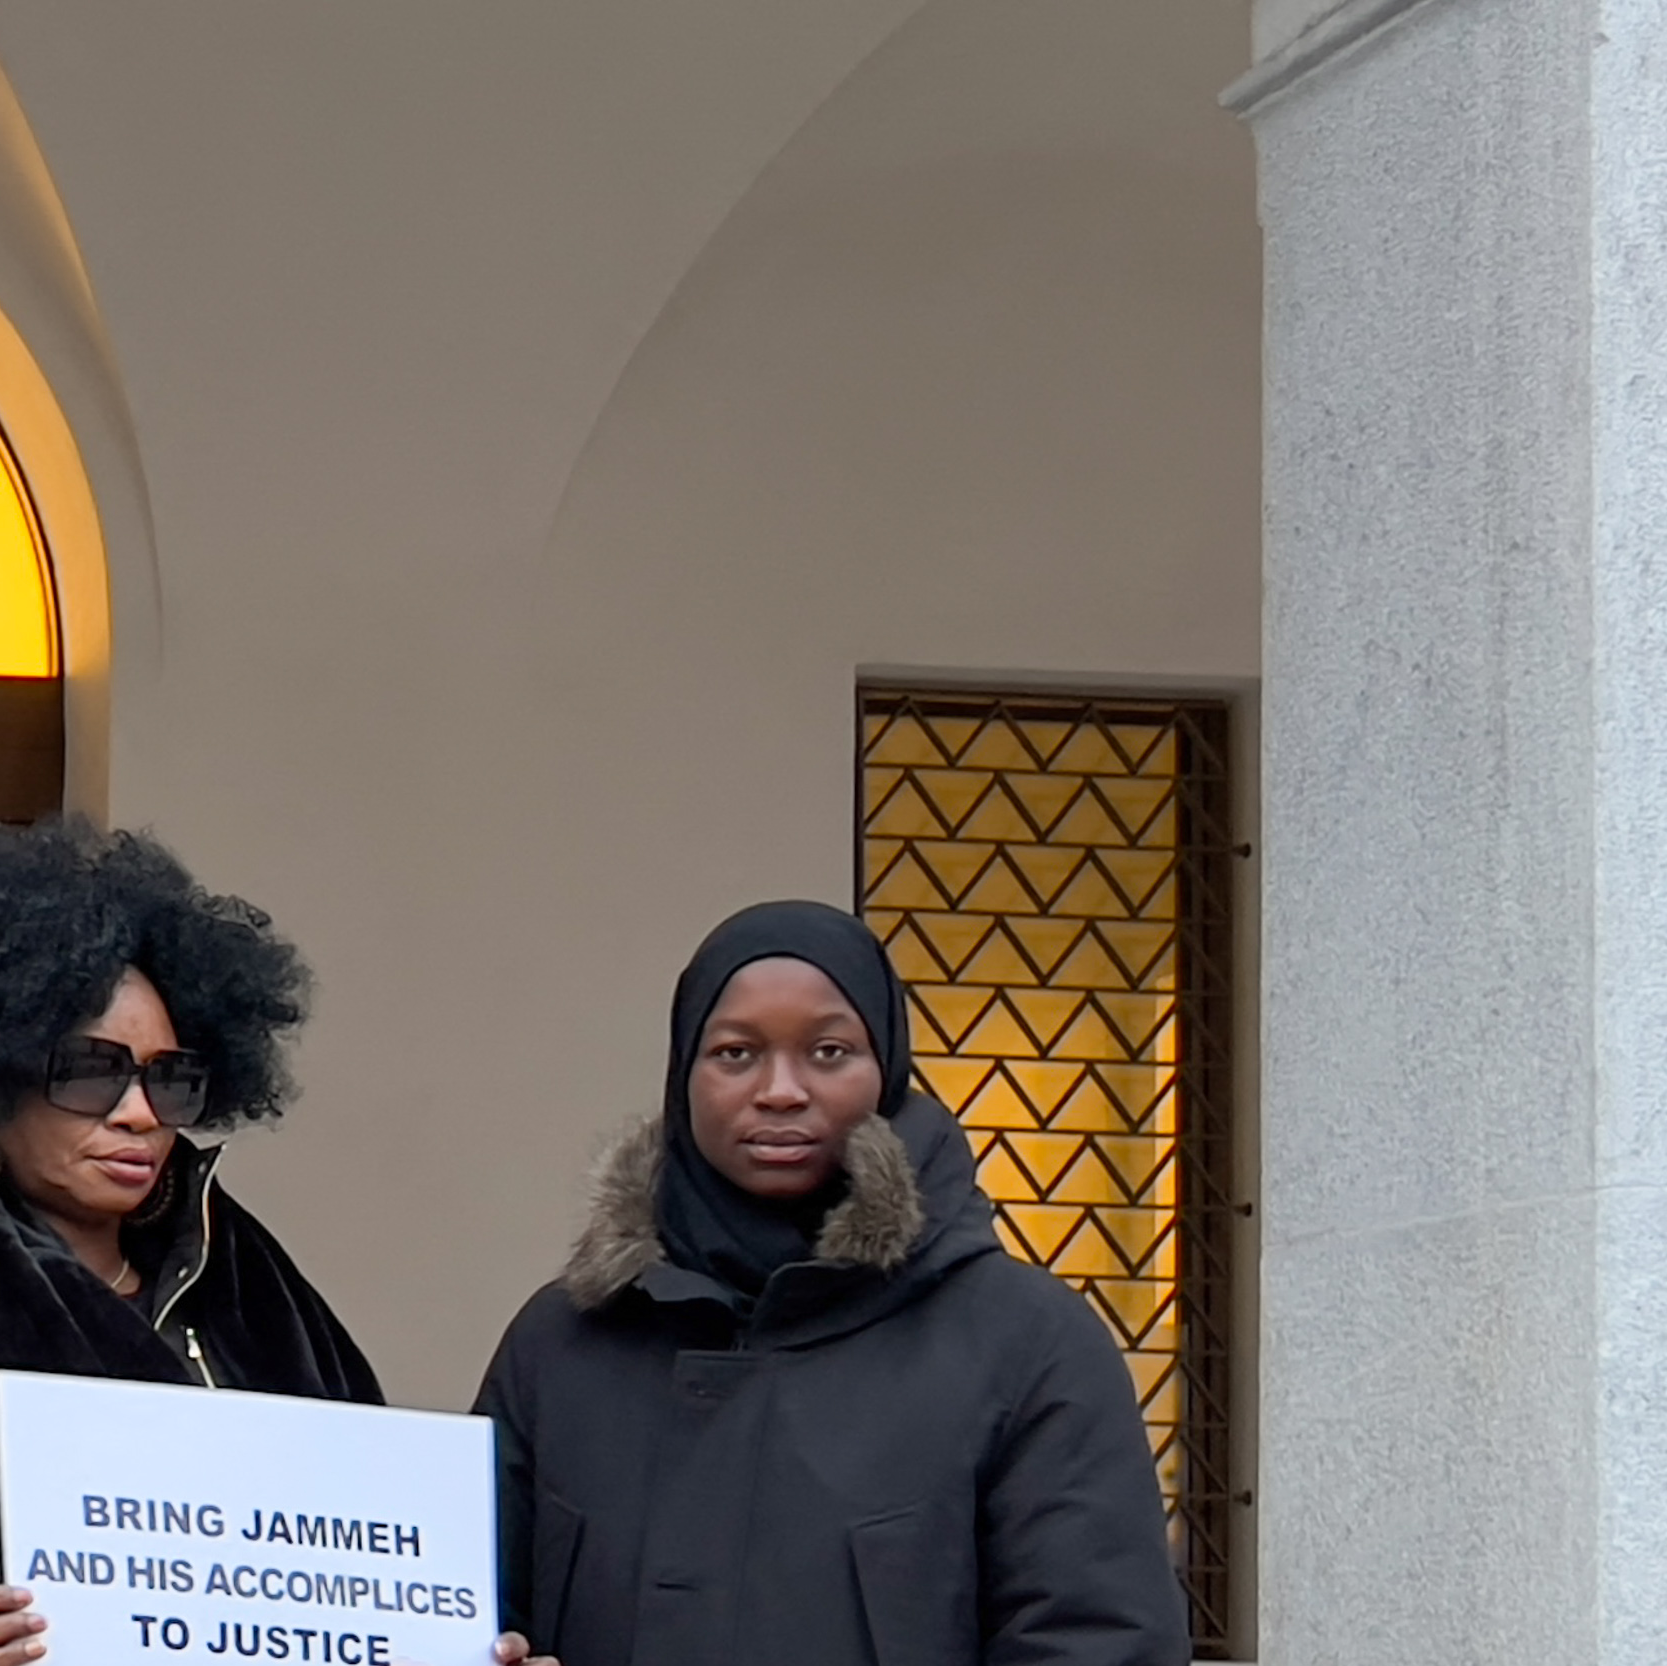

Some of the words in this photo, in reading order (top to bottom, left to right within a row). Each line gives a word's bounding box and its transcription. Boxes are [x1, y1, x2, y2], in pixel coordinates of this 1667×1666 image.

[81, 1494, 225, 1538] BRING
[240, 1508, 421, 1558] JAMMEH
[26, 1548, 115, 1586] AND
[126, 1555, 195, 1593] HIS
[204, 1563, 478, 1620] ACCOMPLICES
[130, 1613, 190, 1651] TO
